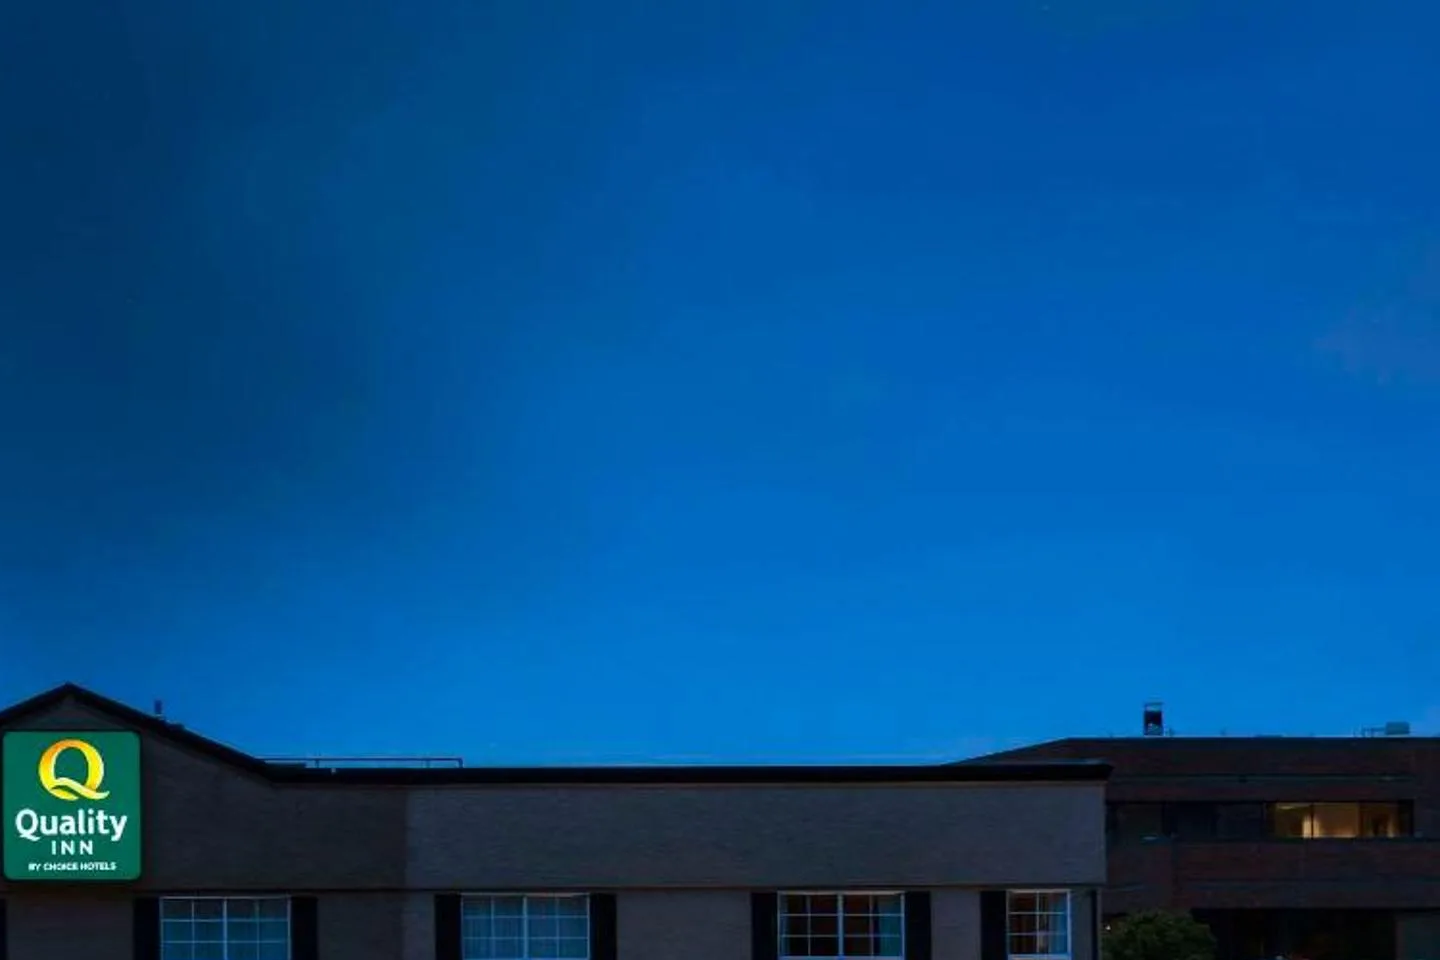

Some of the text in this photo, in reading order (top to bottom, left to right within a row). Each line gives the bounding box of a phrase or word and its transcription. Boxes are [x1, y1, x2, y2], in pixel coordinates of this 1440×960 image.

[38, 739, 110, 800] Q
[15, 808, 127, 841] Quality
[51, 840, 94, 855] INN
[28, 861, 117, 871] BY CHOICE HOTELS
